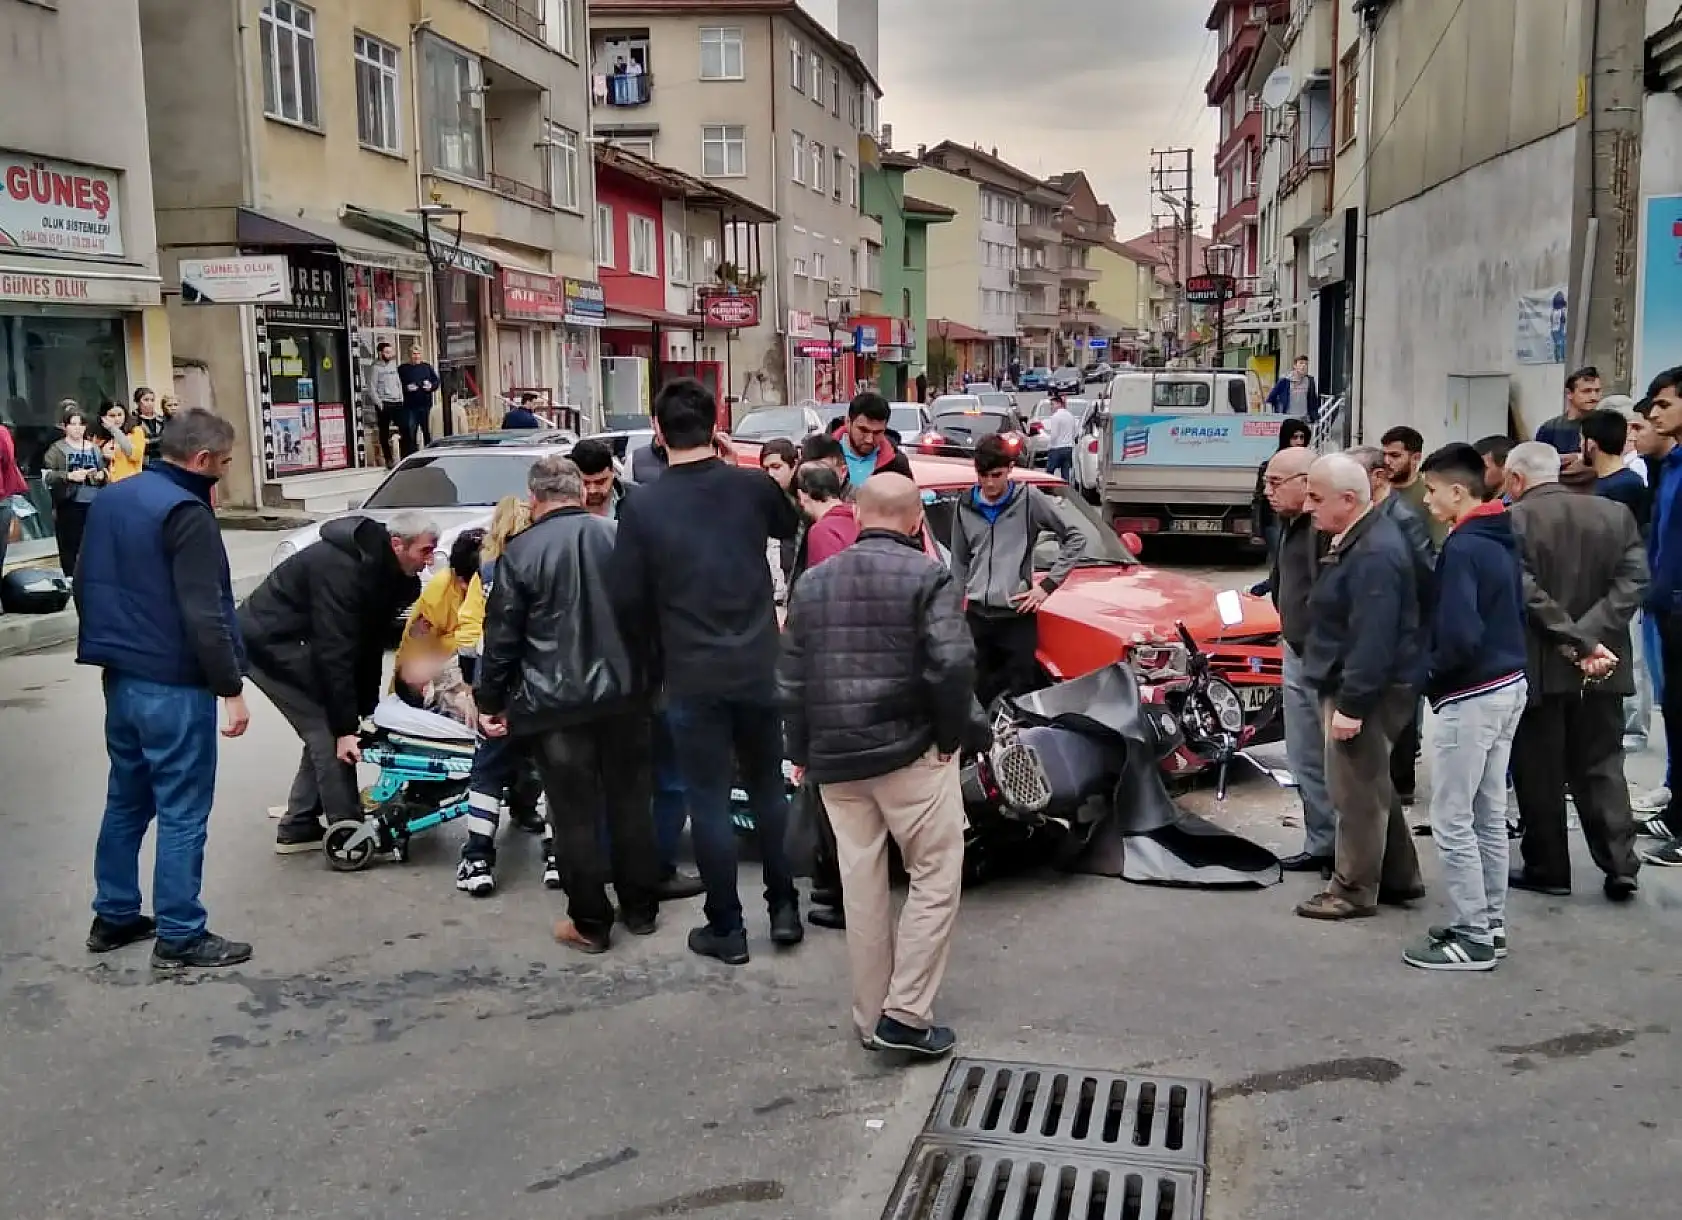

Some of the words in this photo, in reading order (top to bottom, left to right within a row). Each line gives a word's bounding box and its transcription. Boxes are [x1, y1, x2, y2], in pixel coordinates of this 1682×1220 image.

[6, 162, 110, 219] GÜNEŞ
[41, 216, 64, 230] OLUK
[55, 279, 88, 297] OLUK
[295, 294, 327, 310] SAAT
